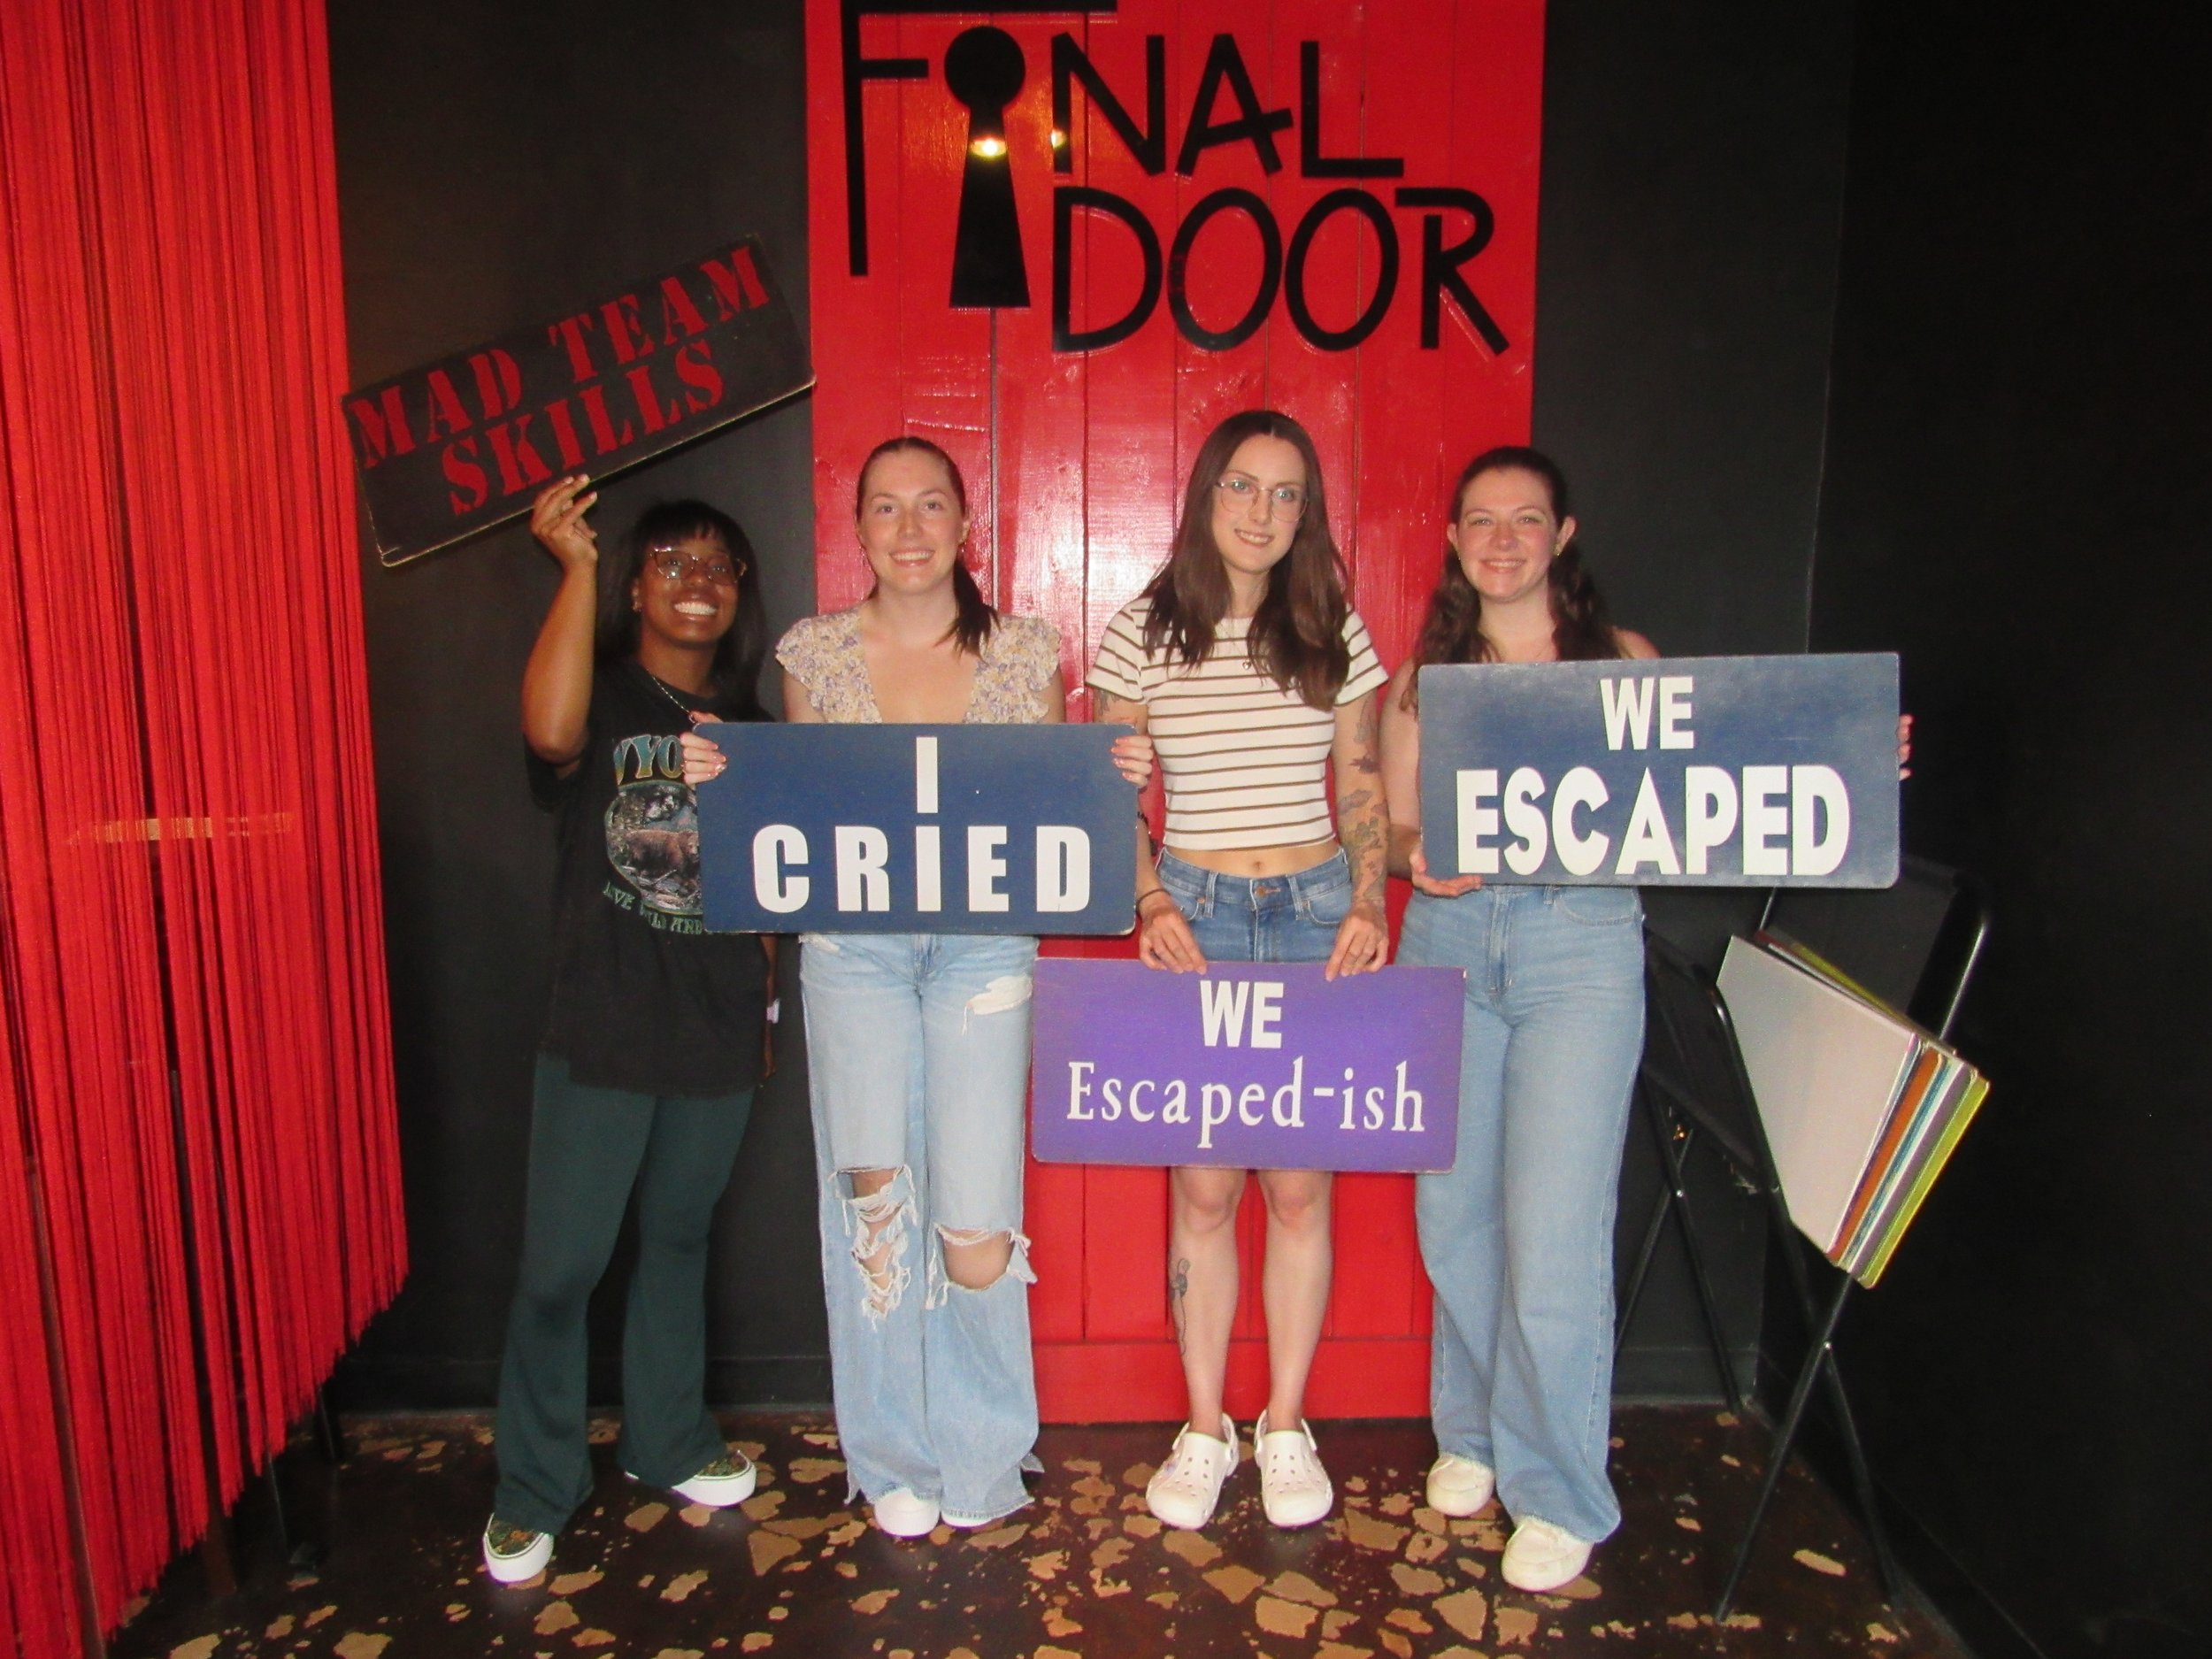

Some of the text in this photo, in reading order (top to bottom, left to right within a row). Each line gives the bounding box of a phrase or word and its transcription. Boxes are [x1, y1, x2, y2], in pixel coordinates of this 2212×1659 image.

[841, 0, 1404, 308] FINAL
[1053, 187, 1509, 355] DOOR
[349, 245, 770, 469] MAD TEAM
[442, 339, 724, 516] SKILLS
[1599, 676, 1695, 750] WE
[916, 737, 939, 813] I
[1456, 765, 1850, 876] ESCAPED
[752, 824, 1091, 913] CRIED
[1200, 979, 1285, 1049] WE
[1067, 1056, 1425, 1148] Escaped-ish
